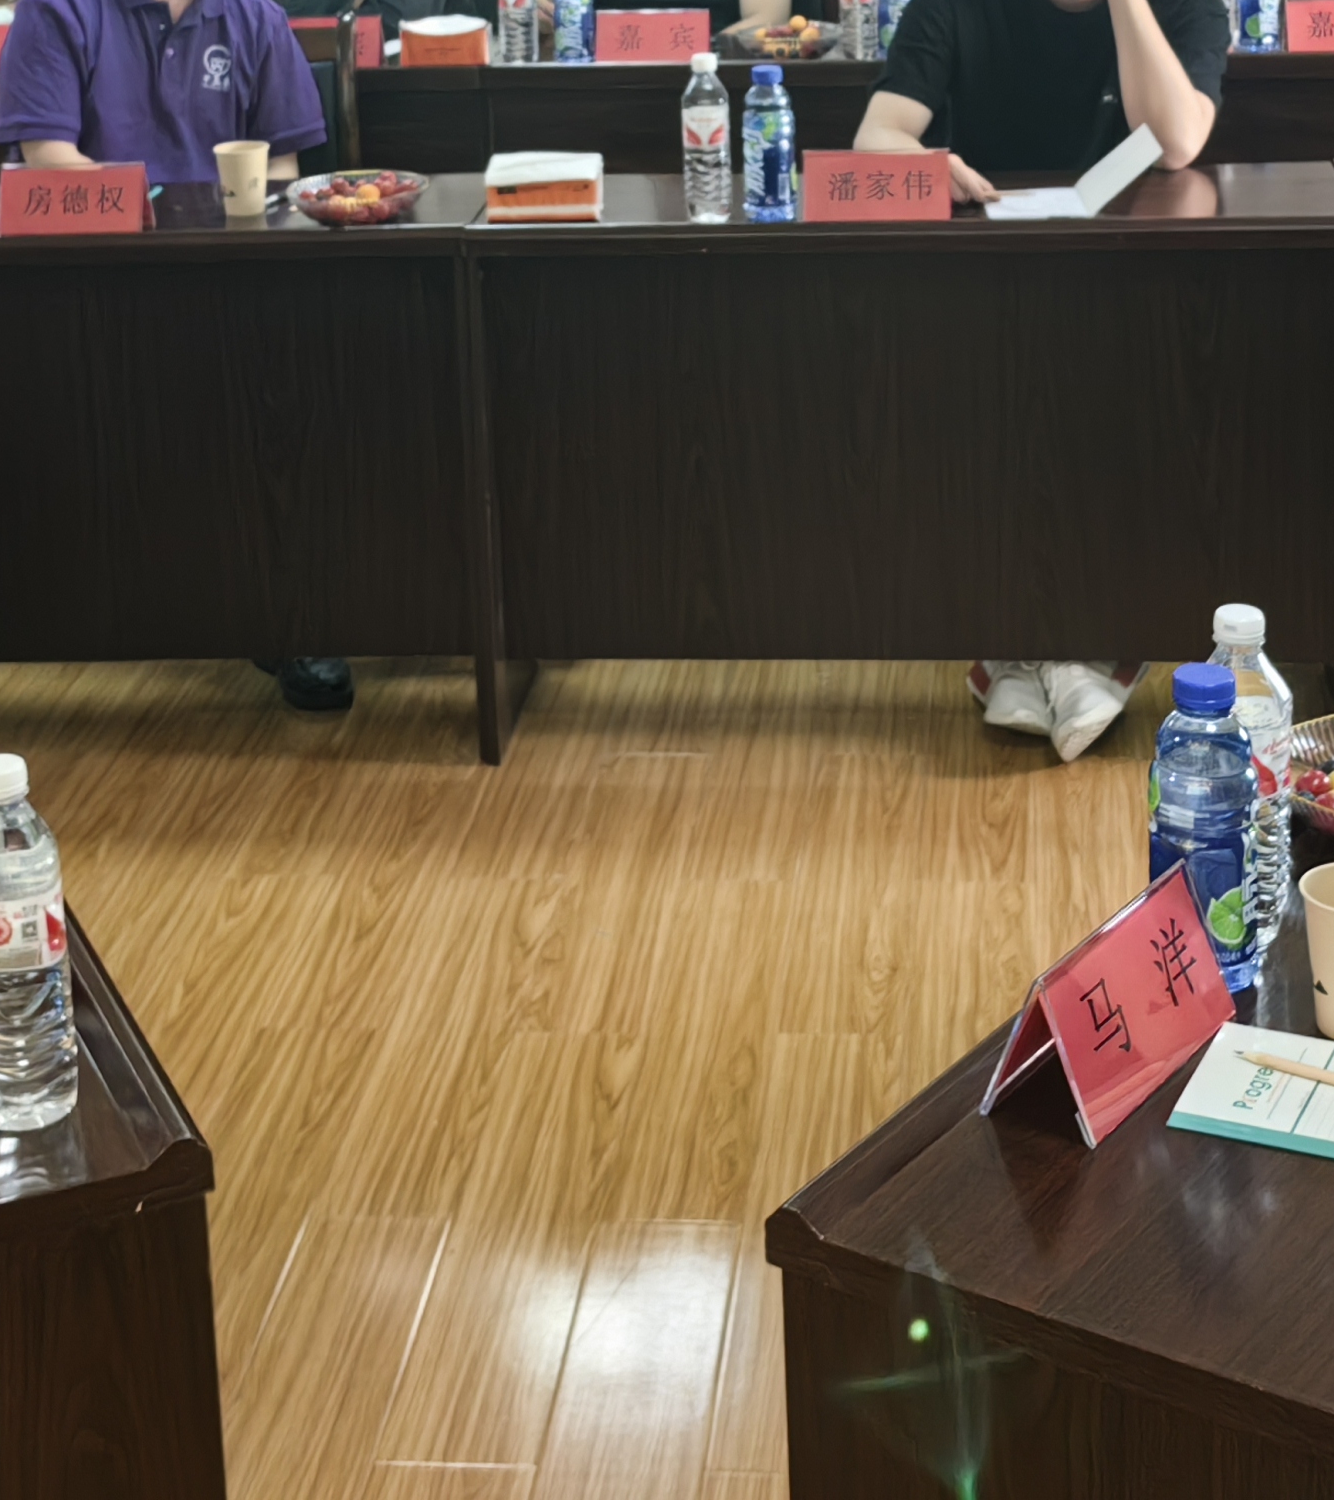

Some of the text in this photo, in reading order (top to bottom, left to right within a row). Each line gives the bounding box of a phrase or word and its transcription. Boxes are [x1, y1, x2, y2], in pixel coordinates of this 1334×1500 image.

[617, 23, 696, 52] 嘉宾
[24, 184, 125, 216] 房德权
[828, 169, 933, 202] 潘家伟
[1080, 917, 1197, 1054] 马洋
[1232, 1064, 1274, 1111] Progre
